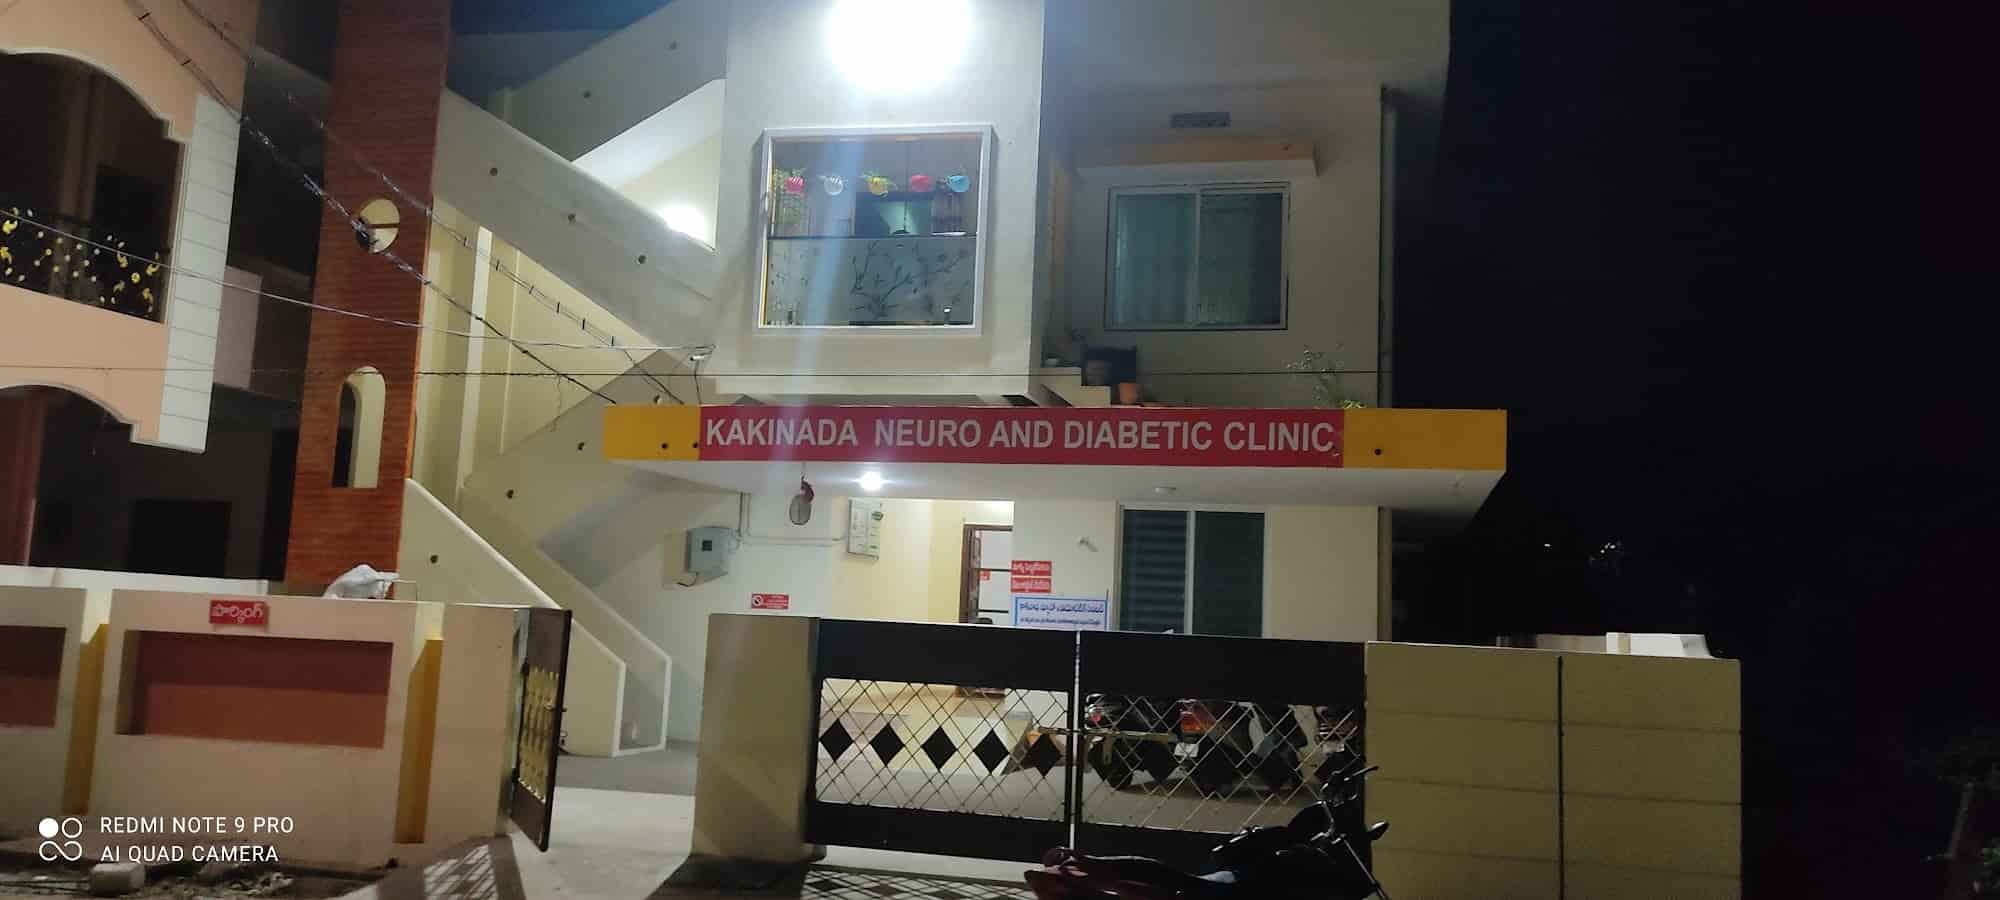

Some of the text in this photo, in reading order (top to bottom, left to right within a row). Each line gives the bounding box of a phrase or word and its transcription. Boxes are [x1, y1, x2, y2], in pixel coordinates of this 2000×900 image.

[706, 418, 1334, 451] KAKINADA NEURO AND DIABETIC CLINIC
